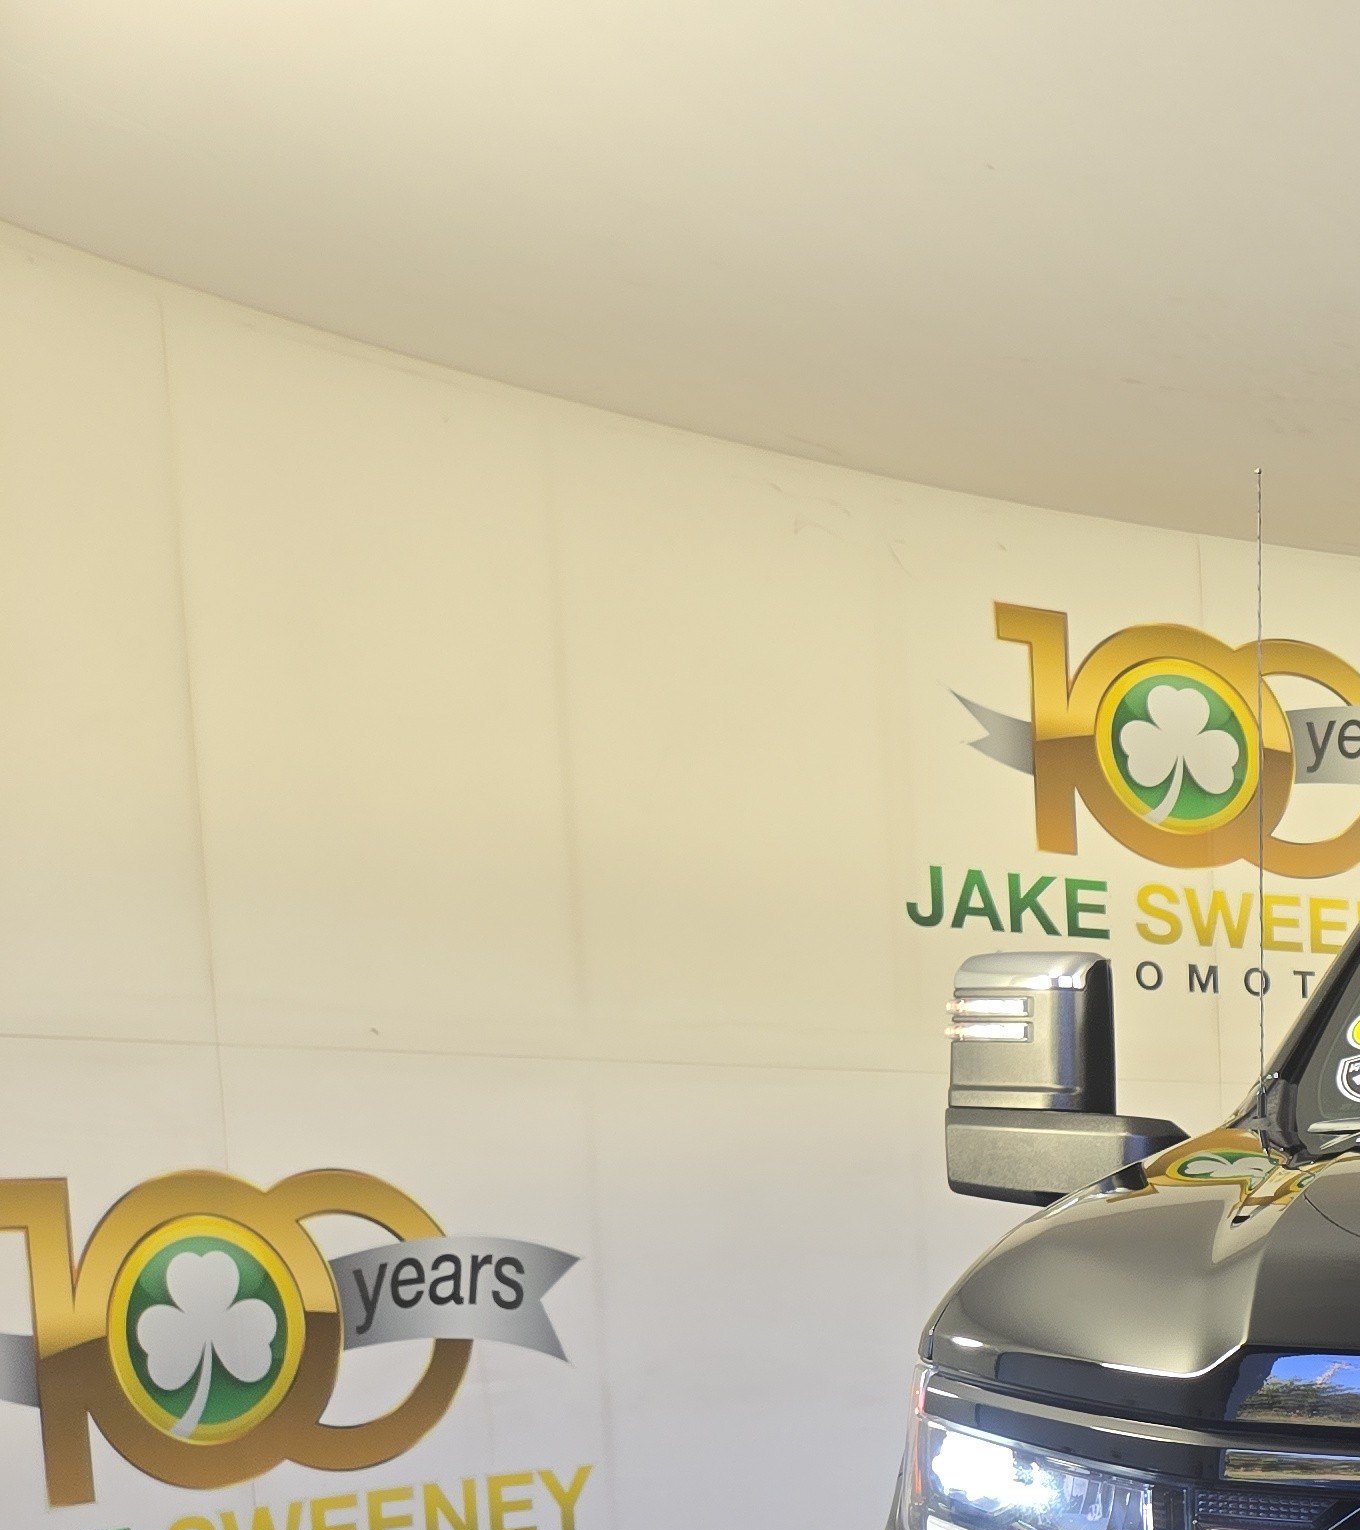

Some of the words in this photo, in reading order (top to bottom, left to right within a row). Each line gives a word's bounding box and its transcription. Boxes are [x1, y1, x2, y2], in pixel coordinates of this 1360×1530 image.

[906, 865, 1110, 940] JAKE
[1135, 960, 1316, 999] OMOT
[352, 1250, 526, 1334] years
[0, 1169, 474, 1509] 100
